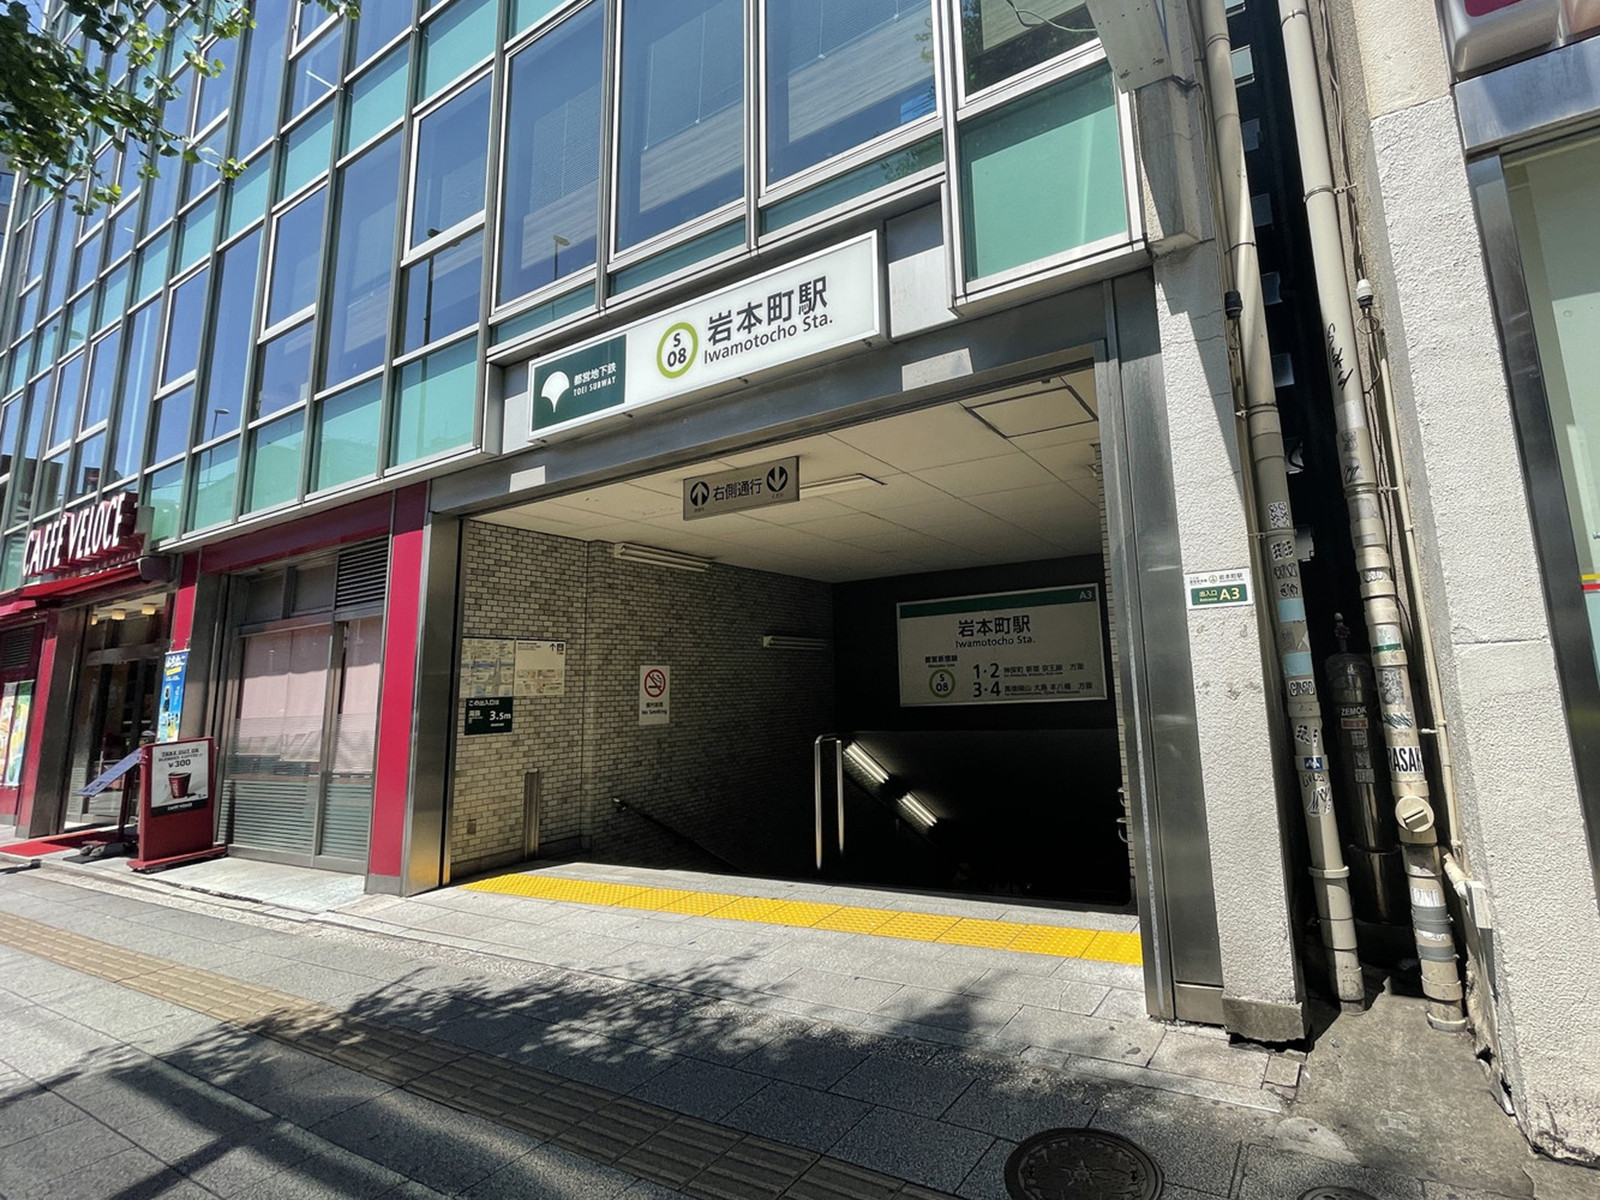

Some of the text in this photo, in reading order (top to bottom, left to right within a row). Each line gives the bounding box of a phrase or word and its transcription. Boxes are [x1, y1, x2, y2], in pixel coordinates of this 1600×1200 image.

[707, 276, 828, 347] 岩本町駅
[672, 332, 682, 348] S
[703, 313, 834, 365] Iwamotocho Sta.
[667, 347, 688, 368] 08
[574, 361, 617, 386] 都営地下鉄
[573, 375, 617, 397] TOEI SUBWAY
[713, 477, 763, 502] 右側通行
[67, 491, 126, 564] VELOCE
[1078, 590, 1093, 601] A3
[1219, 587, 1240, 600] A3
[958, 614, 1032, 638] 岩本町駅
[955, 635, 1037, 649] Iwamotocho Sta.
[935, 681, 949, 692] 08
[939, 673, 945, 682] S
[489, 710, 512, 721] 3.5m
